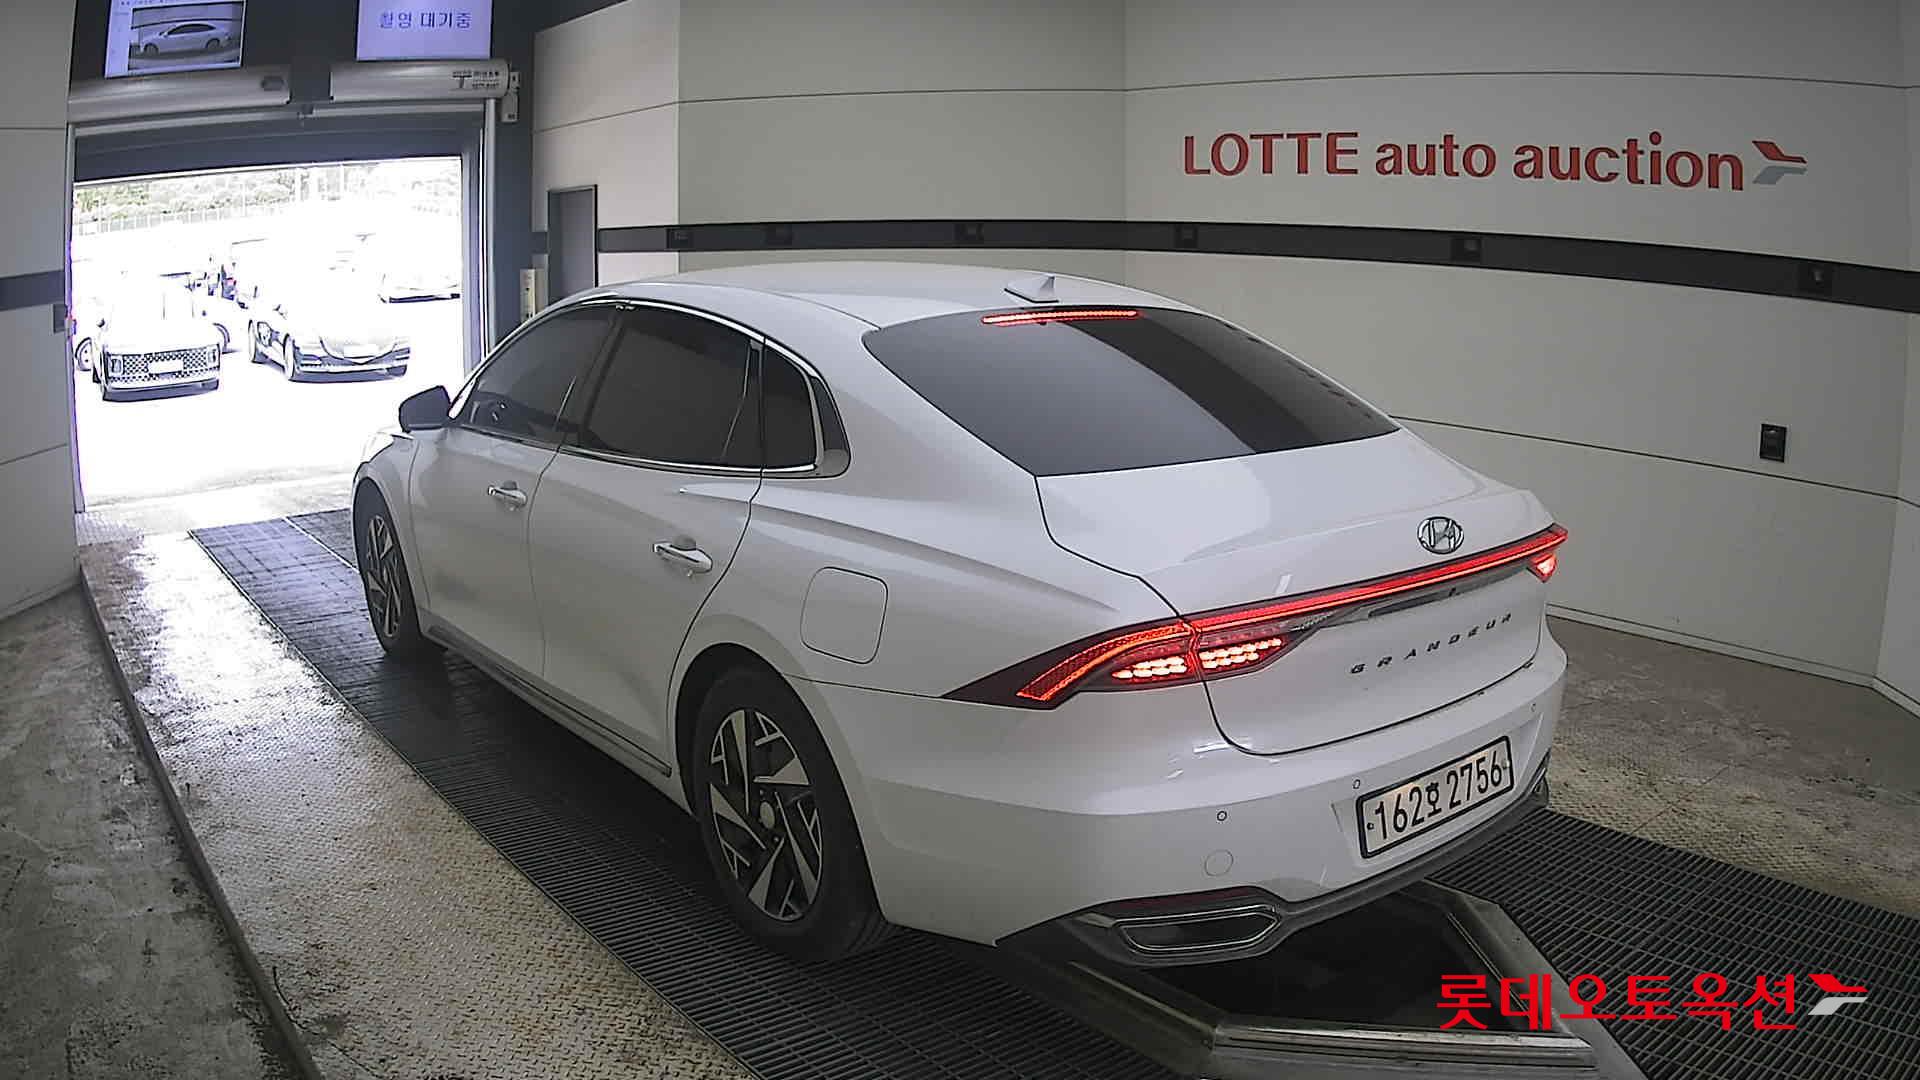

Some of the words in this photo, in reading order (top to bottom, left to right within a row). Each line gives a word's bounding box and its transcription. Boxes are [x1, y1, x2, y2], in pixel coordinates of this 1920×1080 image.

[421, 11, 472, 29] 대기중
[1183, 131, 1359, 176] LOTTE
[1374, 133, 1497, 177] auto
[1512, 131, 1745, 191] auction
[1350, 612, 1512, 675] GRANDEUR
[1374, 782, 1443, 840] 162호
[1446, 750, 1503, 810] 2756
